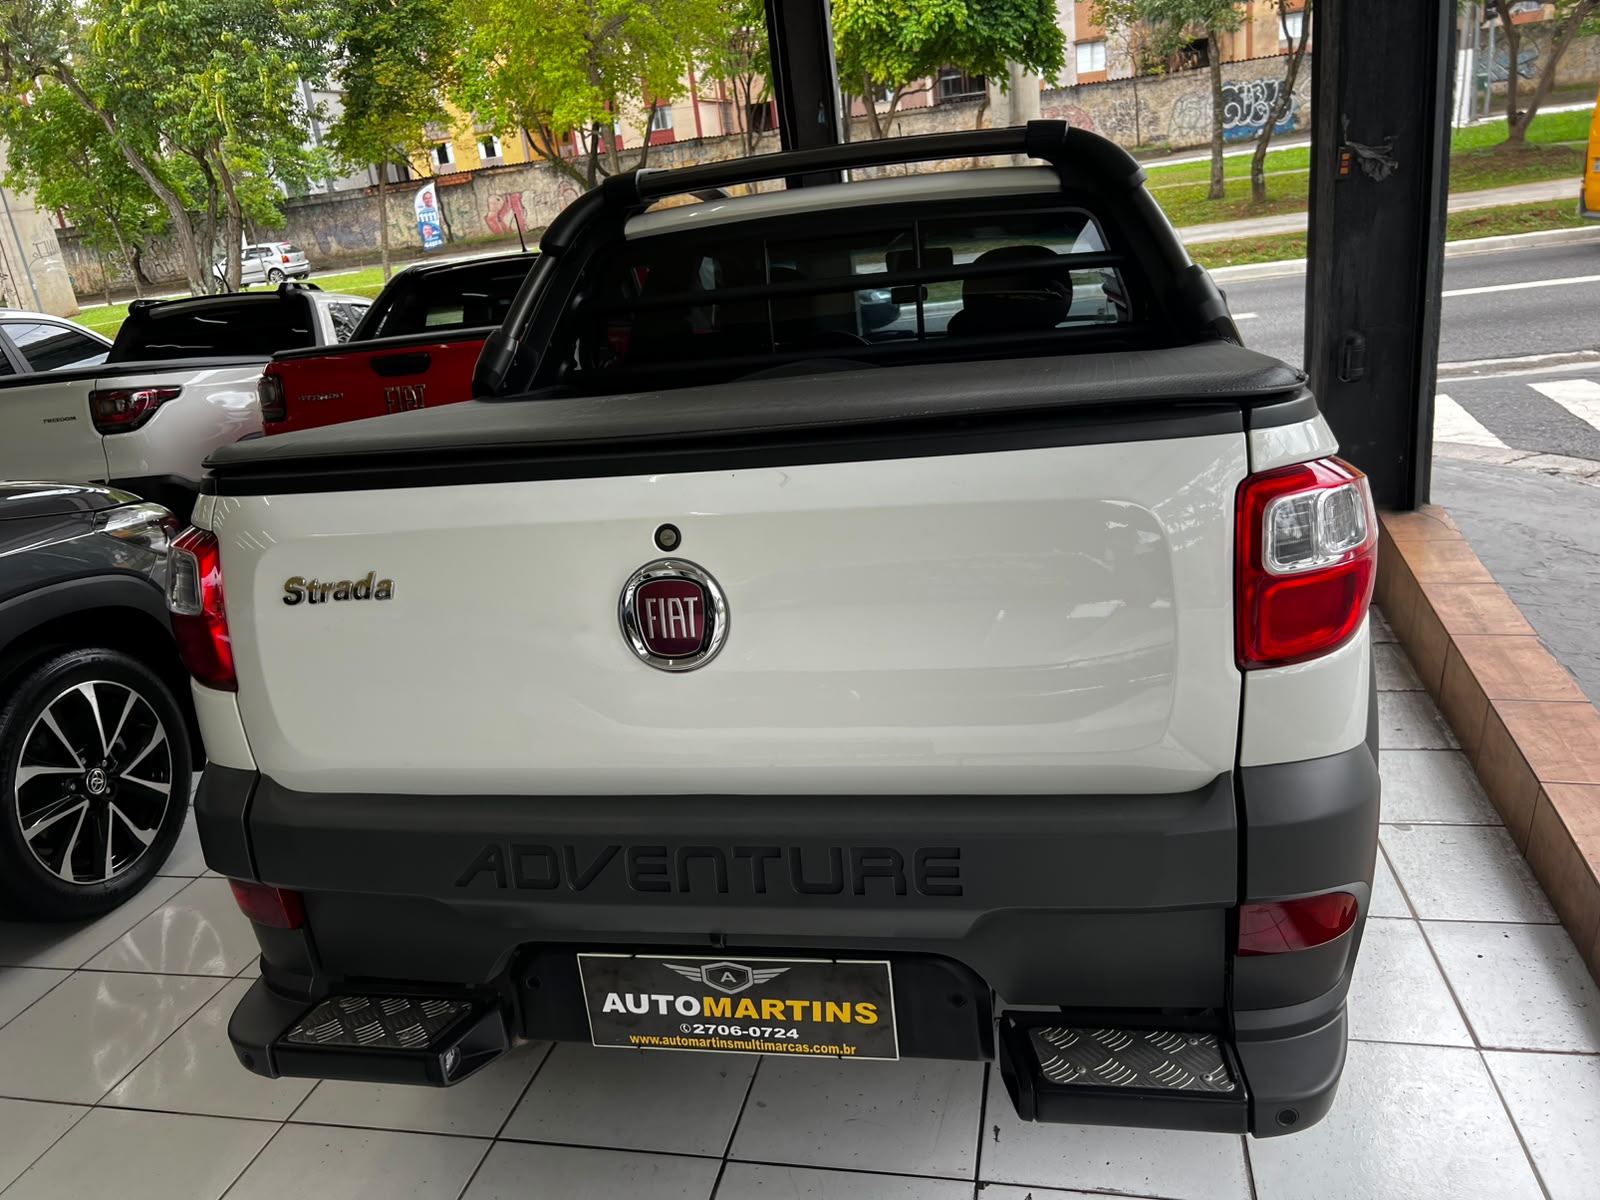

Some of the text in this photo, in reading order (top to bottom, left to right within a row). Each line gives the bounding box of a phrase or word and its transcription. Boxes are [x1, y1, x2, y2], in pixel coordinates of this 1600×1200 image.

[384, 384, 426, 414] FIAT
[282, 571, 395, 606] Strada
[645, 596, 698, 639] FIAT
[454, 844, 964, 897] ADVENTURE
[720, 971, 737, 984] A
[602, 992, 879, 1025] AUTOMARTINS
[629, 1034, 857, 1056] www.automartinsmultimarcas.com.br
[692, 1023, 800, 1040] 2706-0724
